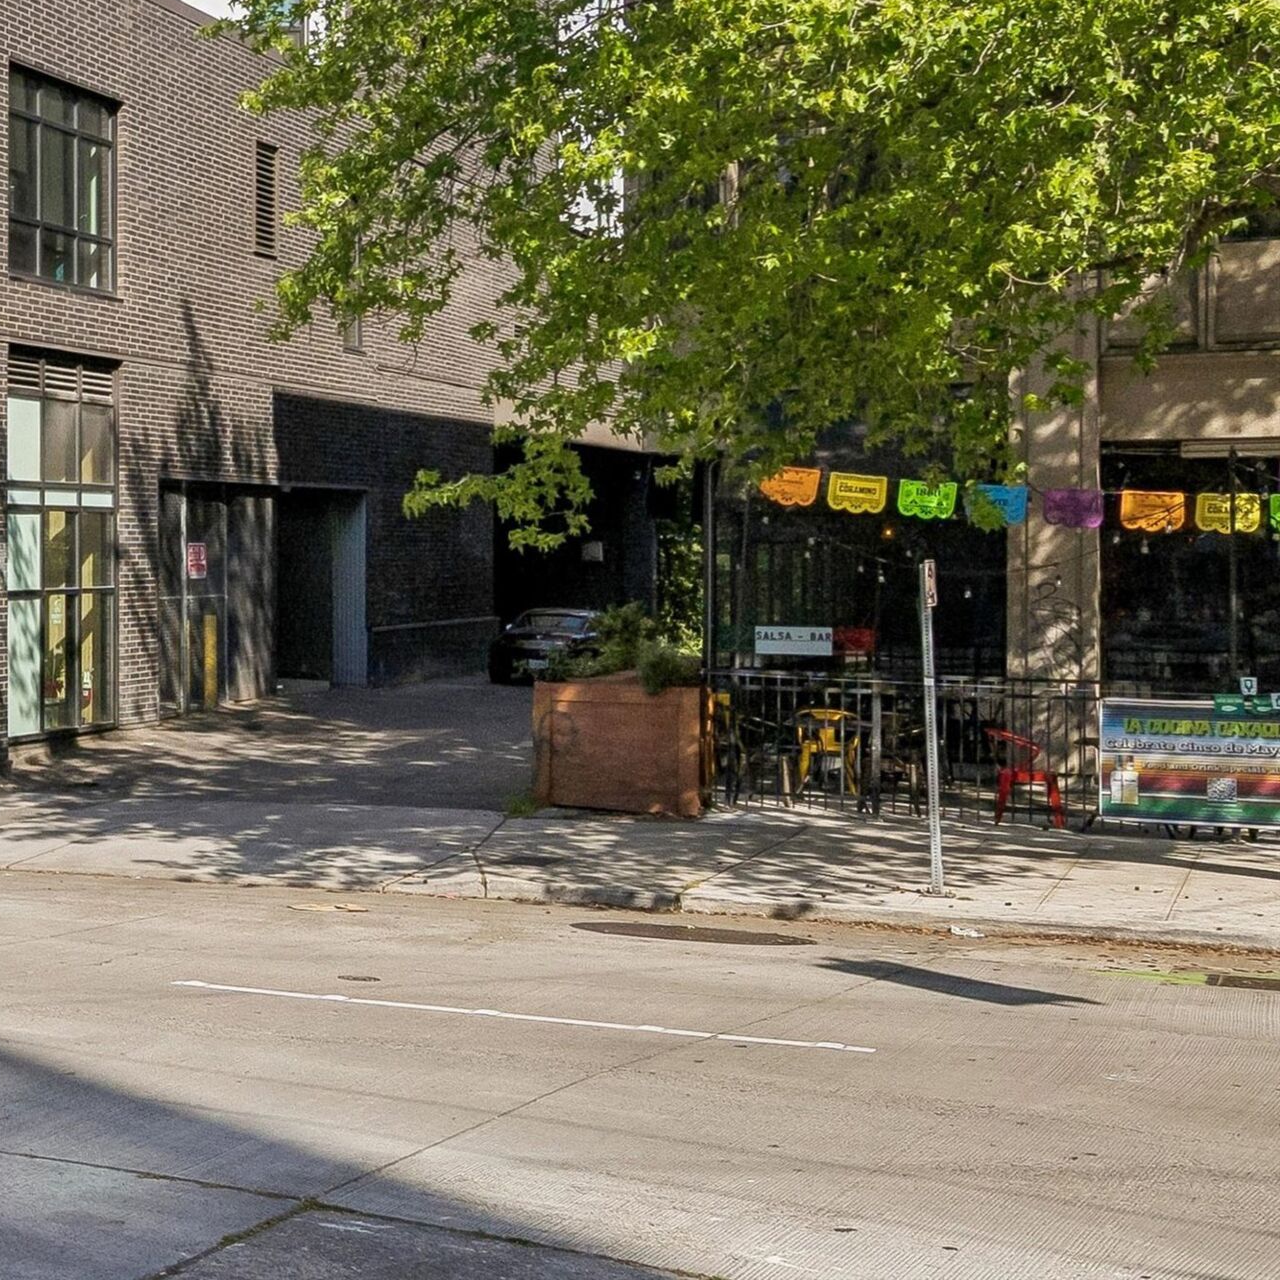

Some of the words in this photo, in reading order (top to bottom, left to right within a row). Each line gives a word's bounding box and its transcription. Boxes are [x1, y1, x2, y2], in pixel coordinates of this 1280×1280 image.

[756, 631, 792, 640] SALSA
[810, 633, 832, 641] BAR
[1105, 738, 1175, 751] Celebrate
[1178, 741, 1221, 753] Cinco
[1224, 742, 1244, 753] de
[1168, 762, 1188, 770] and
